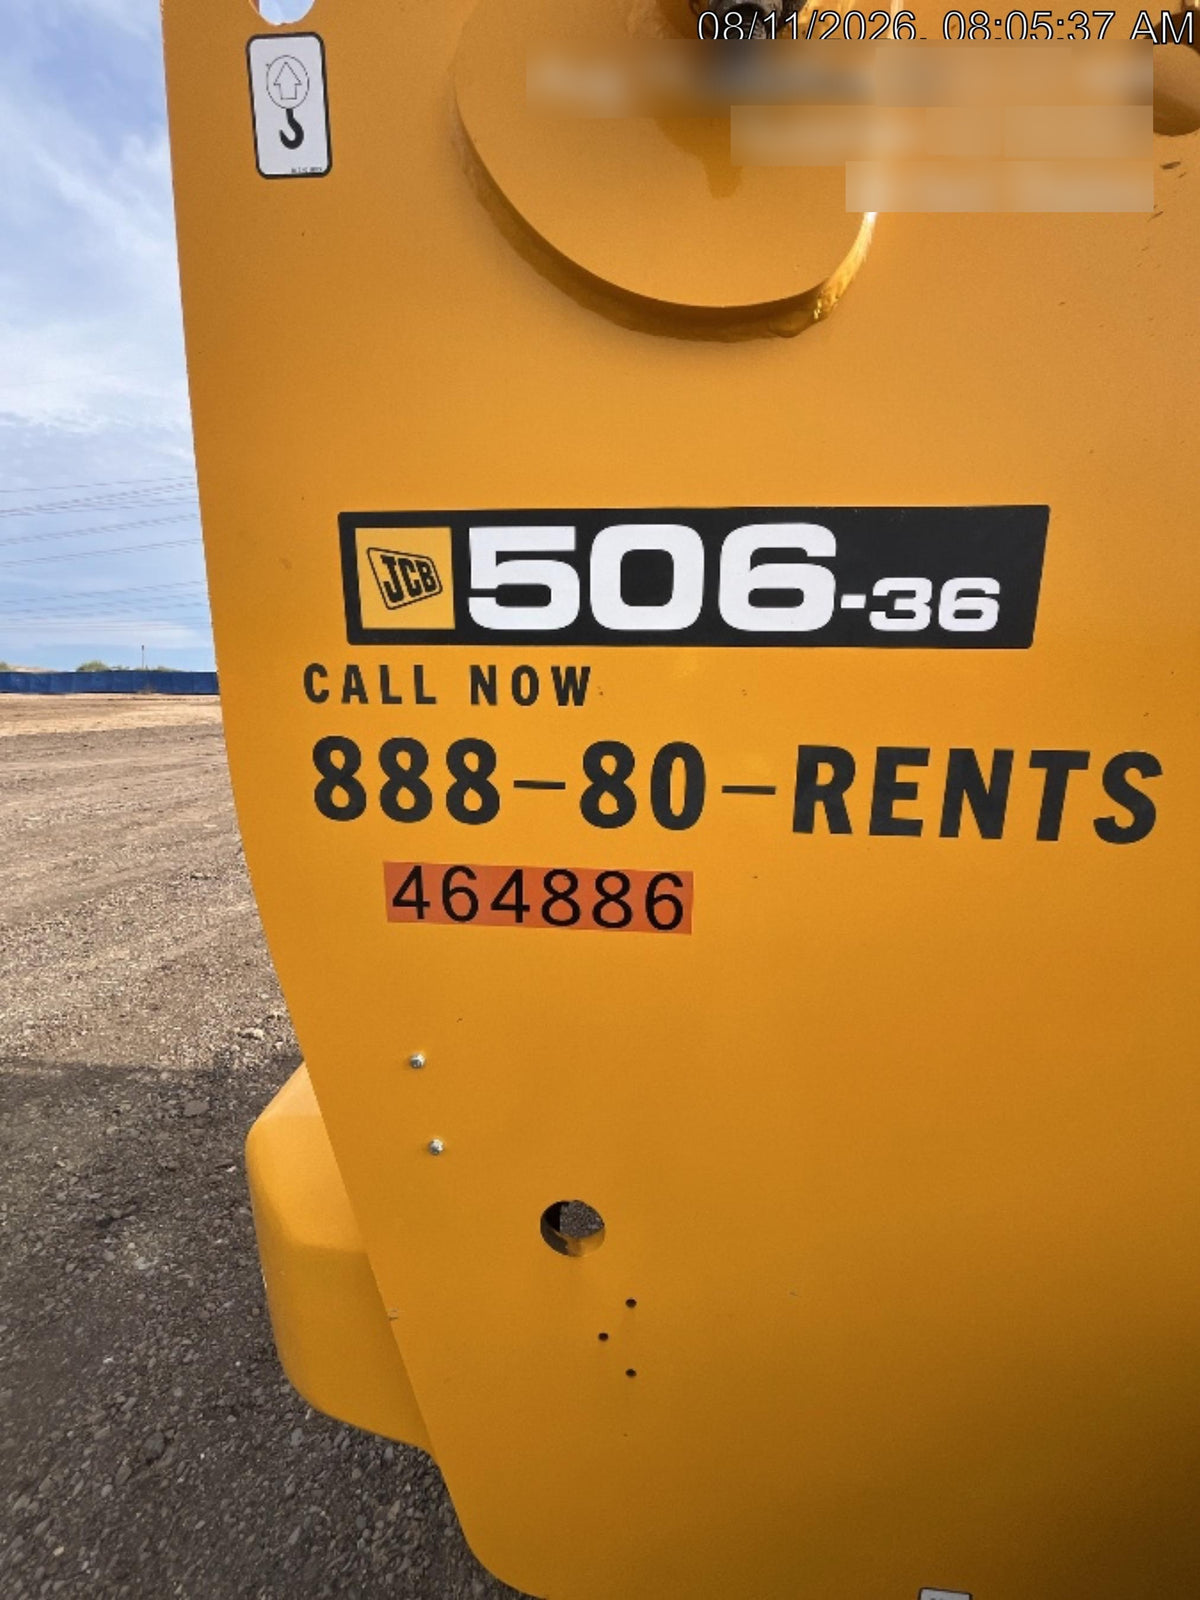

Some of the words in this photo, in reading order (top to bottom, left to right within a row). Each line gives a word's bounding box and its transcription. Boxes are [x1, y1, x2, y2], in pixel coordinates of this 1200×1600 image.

[379, 553, 436, 604] JCB
[467, 522, 1001, 632] 506-36
[303, 663, 437, 705] CALL
[469, 664, 591, 707] NOW
[312, 735, 1164, 845] 888-80-RENTS
[392, 864, 684, 931] 464886
